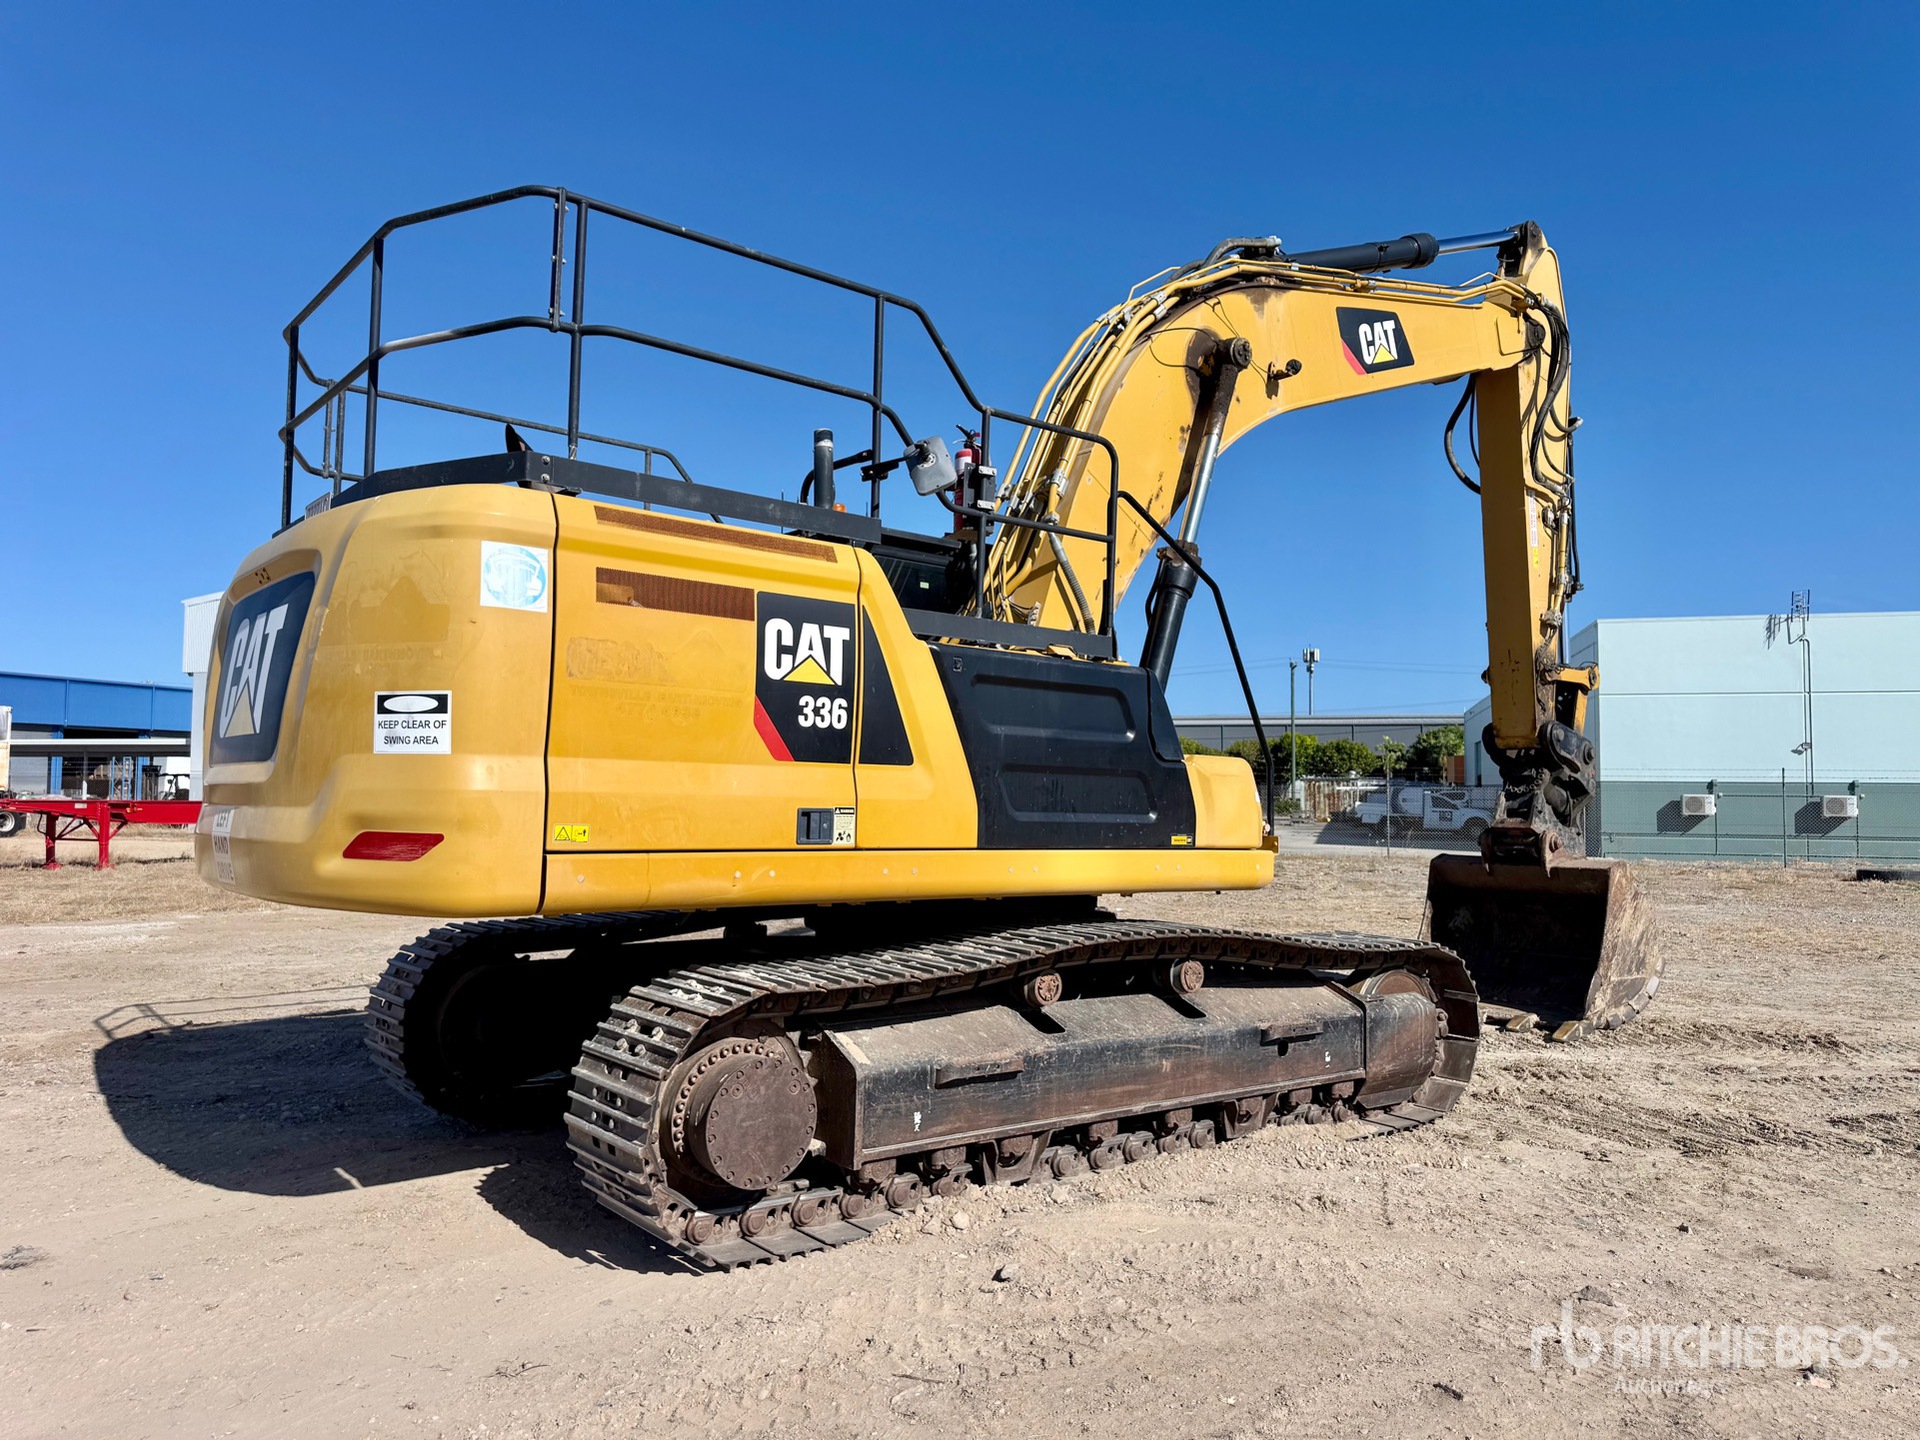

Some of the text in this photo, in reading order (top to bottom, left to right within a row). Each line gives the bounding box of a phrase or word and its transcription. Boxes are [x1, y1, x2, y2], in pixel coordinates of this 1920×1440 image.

[1358, 319, 1398, 365] CAT
[764, 617, 850, 686] CAT
[219, 603, 288, 738] CAT
[377, 719, 447, 729] KEEP CLEAR OF
[797, 695, 848, 730] 336
[383, 735, 439, 745] SWING AREA
[213, 835, 229, 854] HAND
